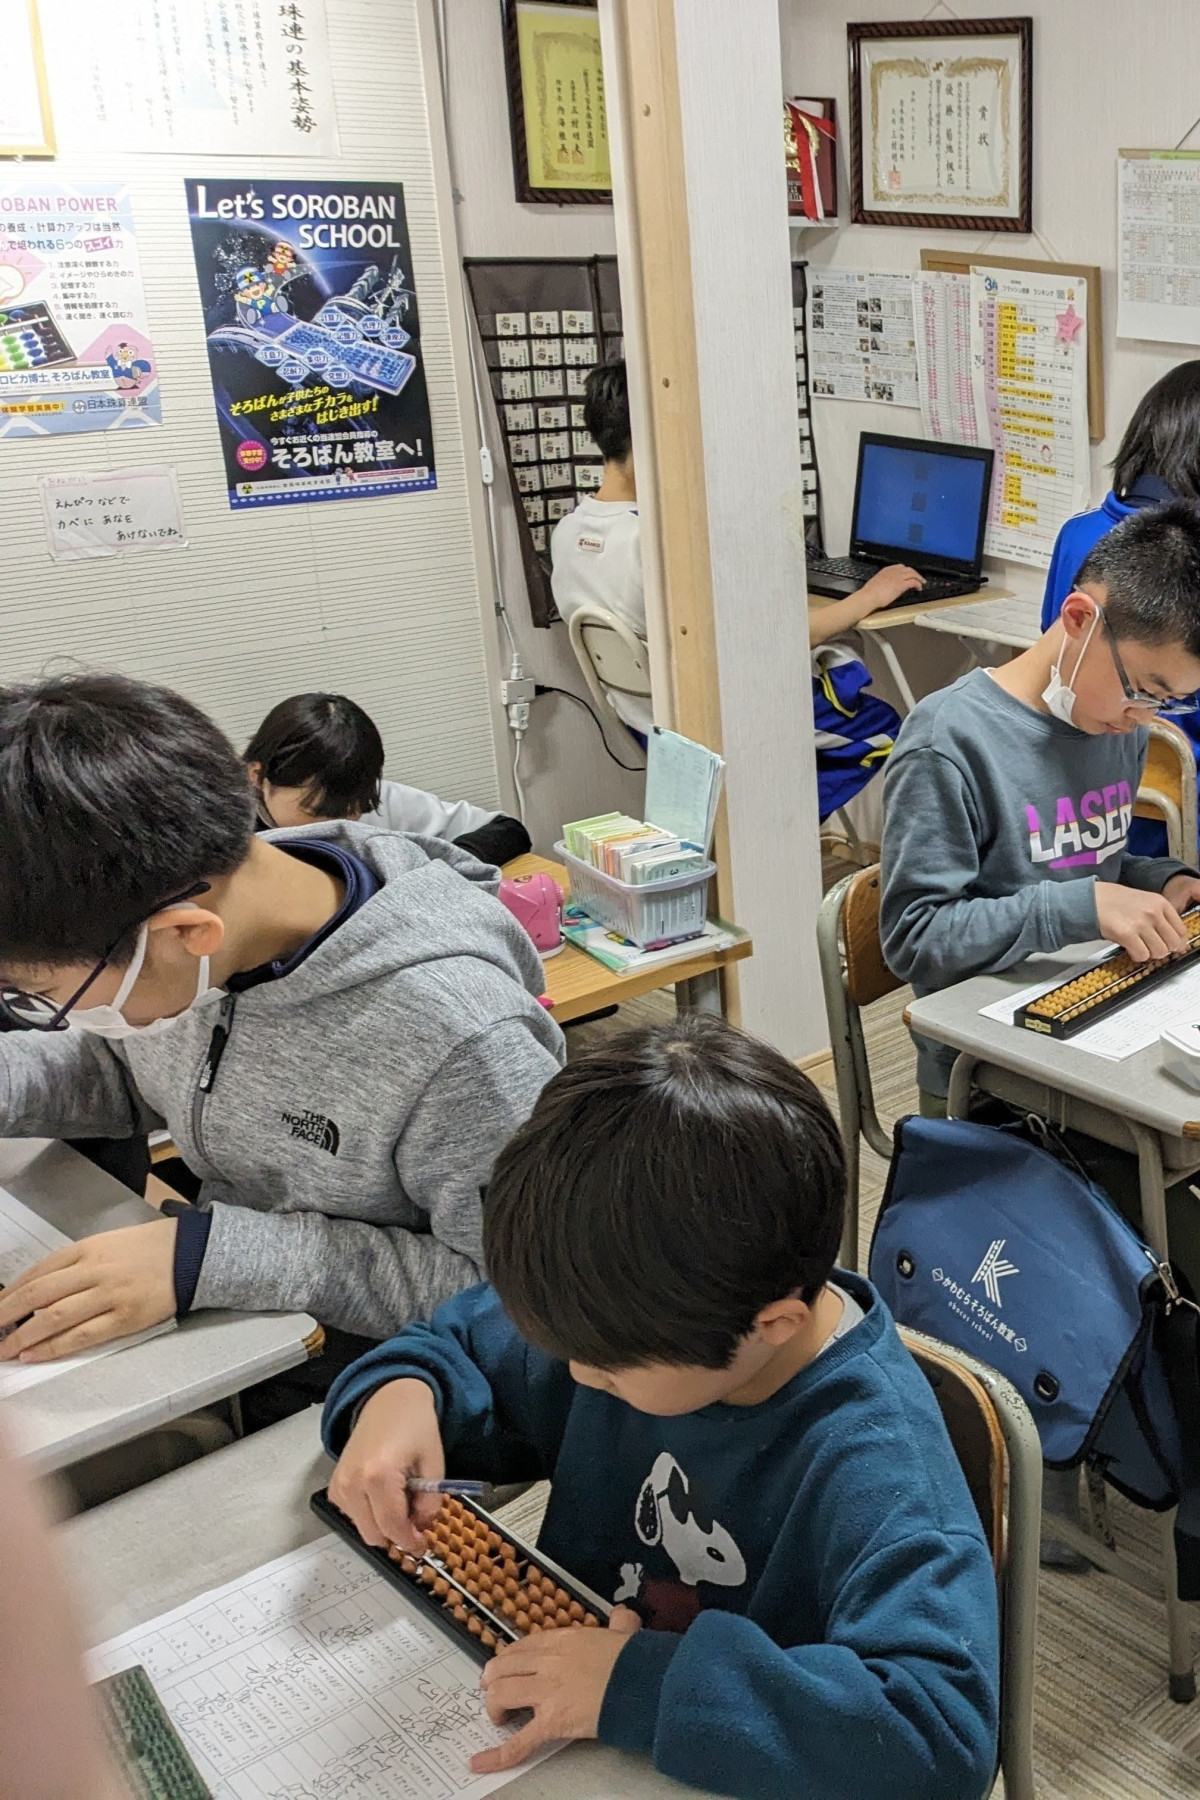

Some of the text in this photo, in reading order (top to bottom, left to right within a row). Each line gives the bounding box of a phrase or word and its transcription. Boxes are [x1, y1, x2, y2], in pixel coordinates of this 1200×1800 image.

[278, 3, 317, 133] 珠連の基本姿勢
[1, 197, 118, 212] OBAN POWER
[197, 185, 396, 219] Let's SOROBAN
[298, 224, 400, 249] SCHOOL
[51, 369, 110, 382] そろばん教室
[87, 397, 148, 409] 日本珠算連盟
[230, 386, 330, 416] そろばんが子供たちの
[270, 391, 353, 422] さまざまなチカラを
[271, 438, 424, 469] そろばん教室へ!
[55, 496, 130, 509] えんぴつ などで
[102, 514, 133, 525] あなを
[281, 1113, 325, 1135] NORTH
[302, 1109, 326, 1125] THE
[291, 1127, 321, 1145] FACE
[942, 1277, 1016, 1343] かわむらそろばん教室
[948, 1301, 993, 1341] abacus school
